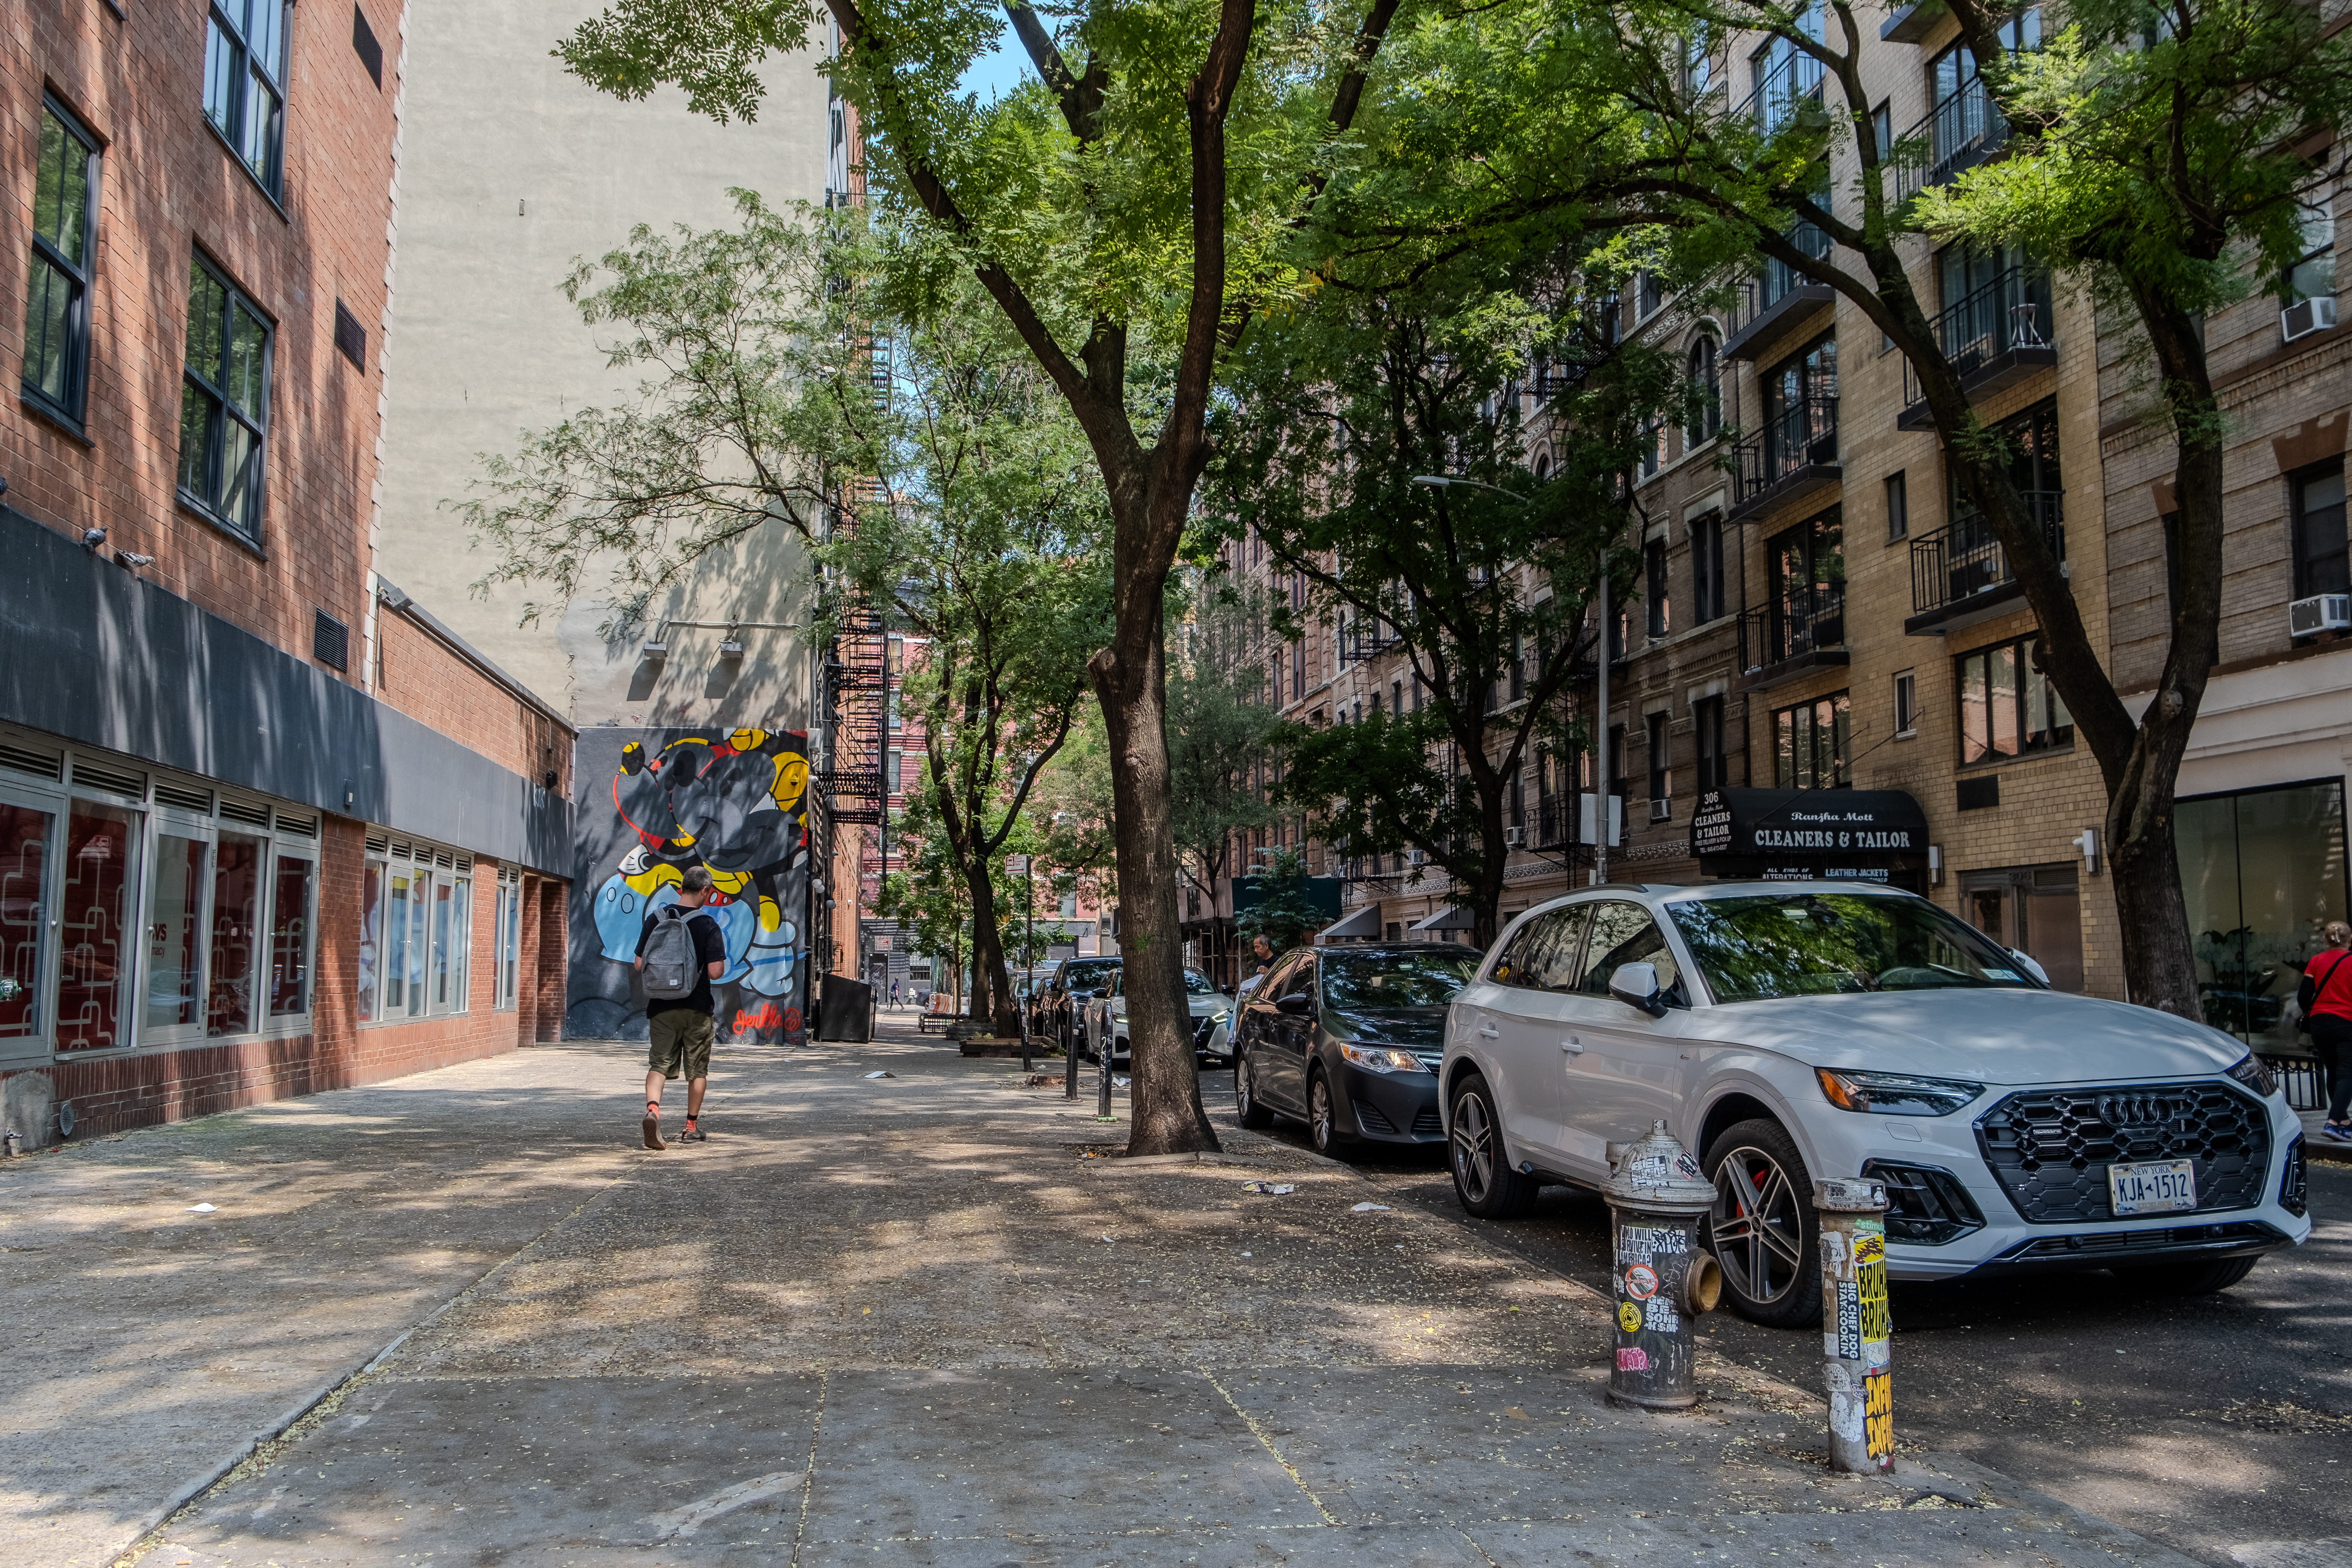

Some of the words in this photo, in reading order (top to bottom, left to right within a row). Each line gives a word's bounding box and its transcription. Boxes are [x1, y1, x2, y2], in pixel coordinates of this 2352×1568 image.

[1705, 791, 1718, 804] 306
[1696, 812, 1730, 826] CLEANERS
[1792, 812, 1840, 823] Ranjha
[1843, 812, 1874, 821] Mott
[1697, 830, 1702, 839] &
[1704, 825, 1729, 837] TAILOR
[1755, 830, 1833, 847] CLEANERS
[1839, 831, 1849, 847] &
[1856, 831, 1910, 847] TAILOR
[1825, 869, 1857, 877] LEATHER
[1858, 869, 1888, 877] JACKETS
[2131, 1168, 2148, 1176] NEW
[2150, 1165, 2171, 1174] YORK
[2118, 1177, 2145, 1202] KJA
[2153, 1173, 2188, 1199] 1512
[1635, 1228, 1651, 1241] WILL
[1645, 1241, 1651, 1254] IN
[1848, 1283, 1857, 1301] BIG
[1848, 1305, 1858, 1331] CHEF
[1840, 1310, 1849, 1355] COOKIN
[1849, 1334, 1858, 1358] DOG
